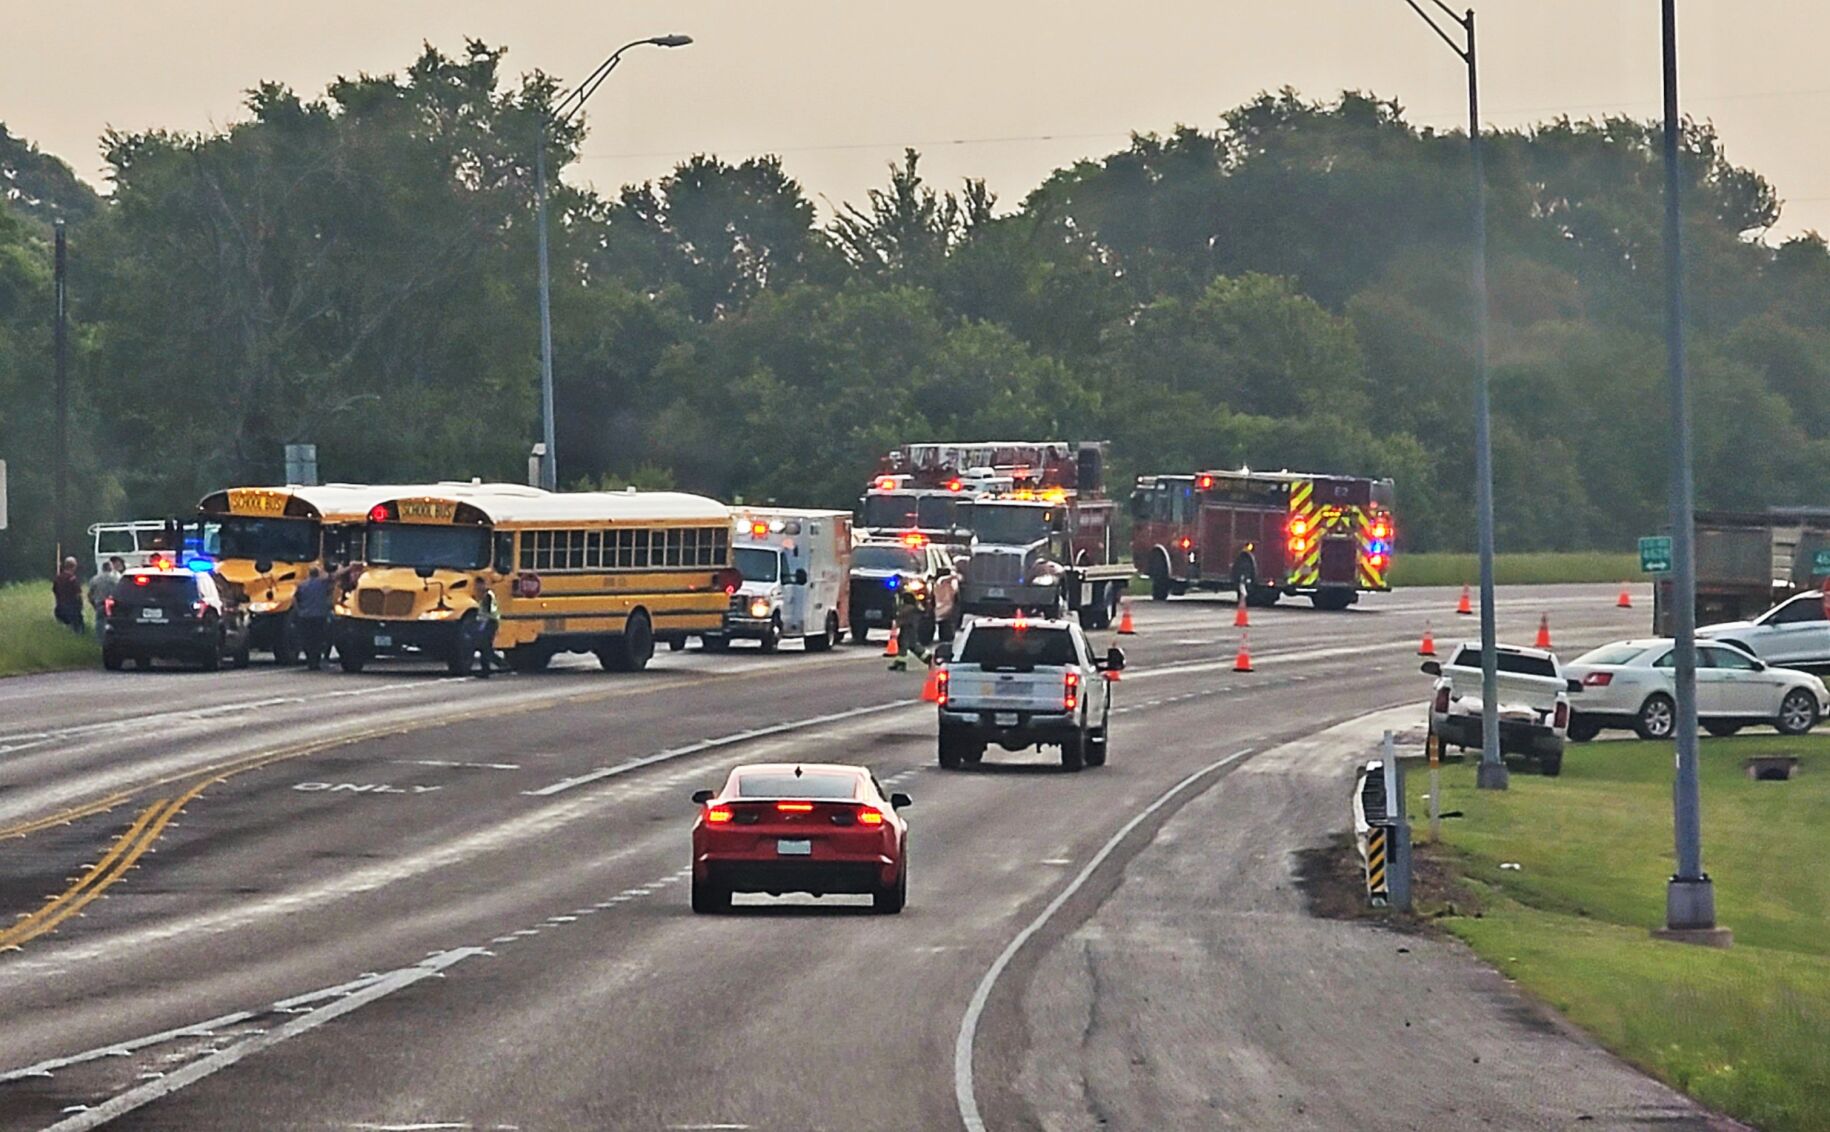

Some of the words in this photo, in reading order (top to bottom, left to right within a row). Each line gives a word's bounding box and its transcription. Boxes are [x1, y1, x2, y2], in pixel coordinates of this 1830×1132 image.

[232, 495, 261, 510] SCHOOL
[265, 497, 282, 512] BUS
[402, 502, 431, 517] SCHOOL
[434, 504, 452, 519] BUS
[292, 782, 442, 793] ONLY
